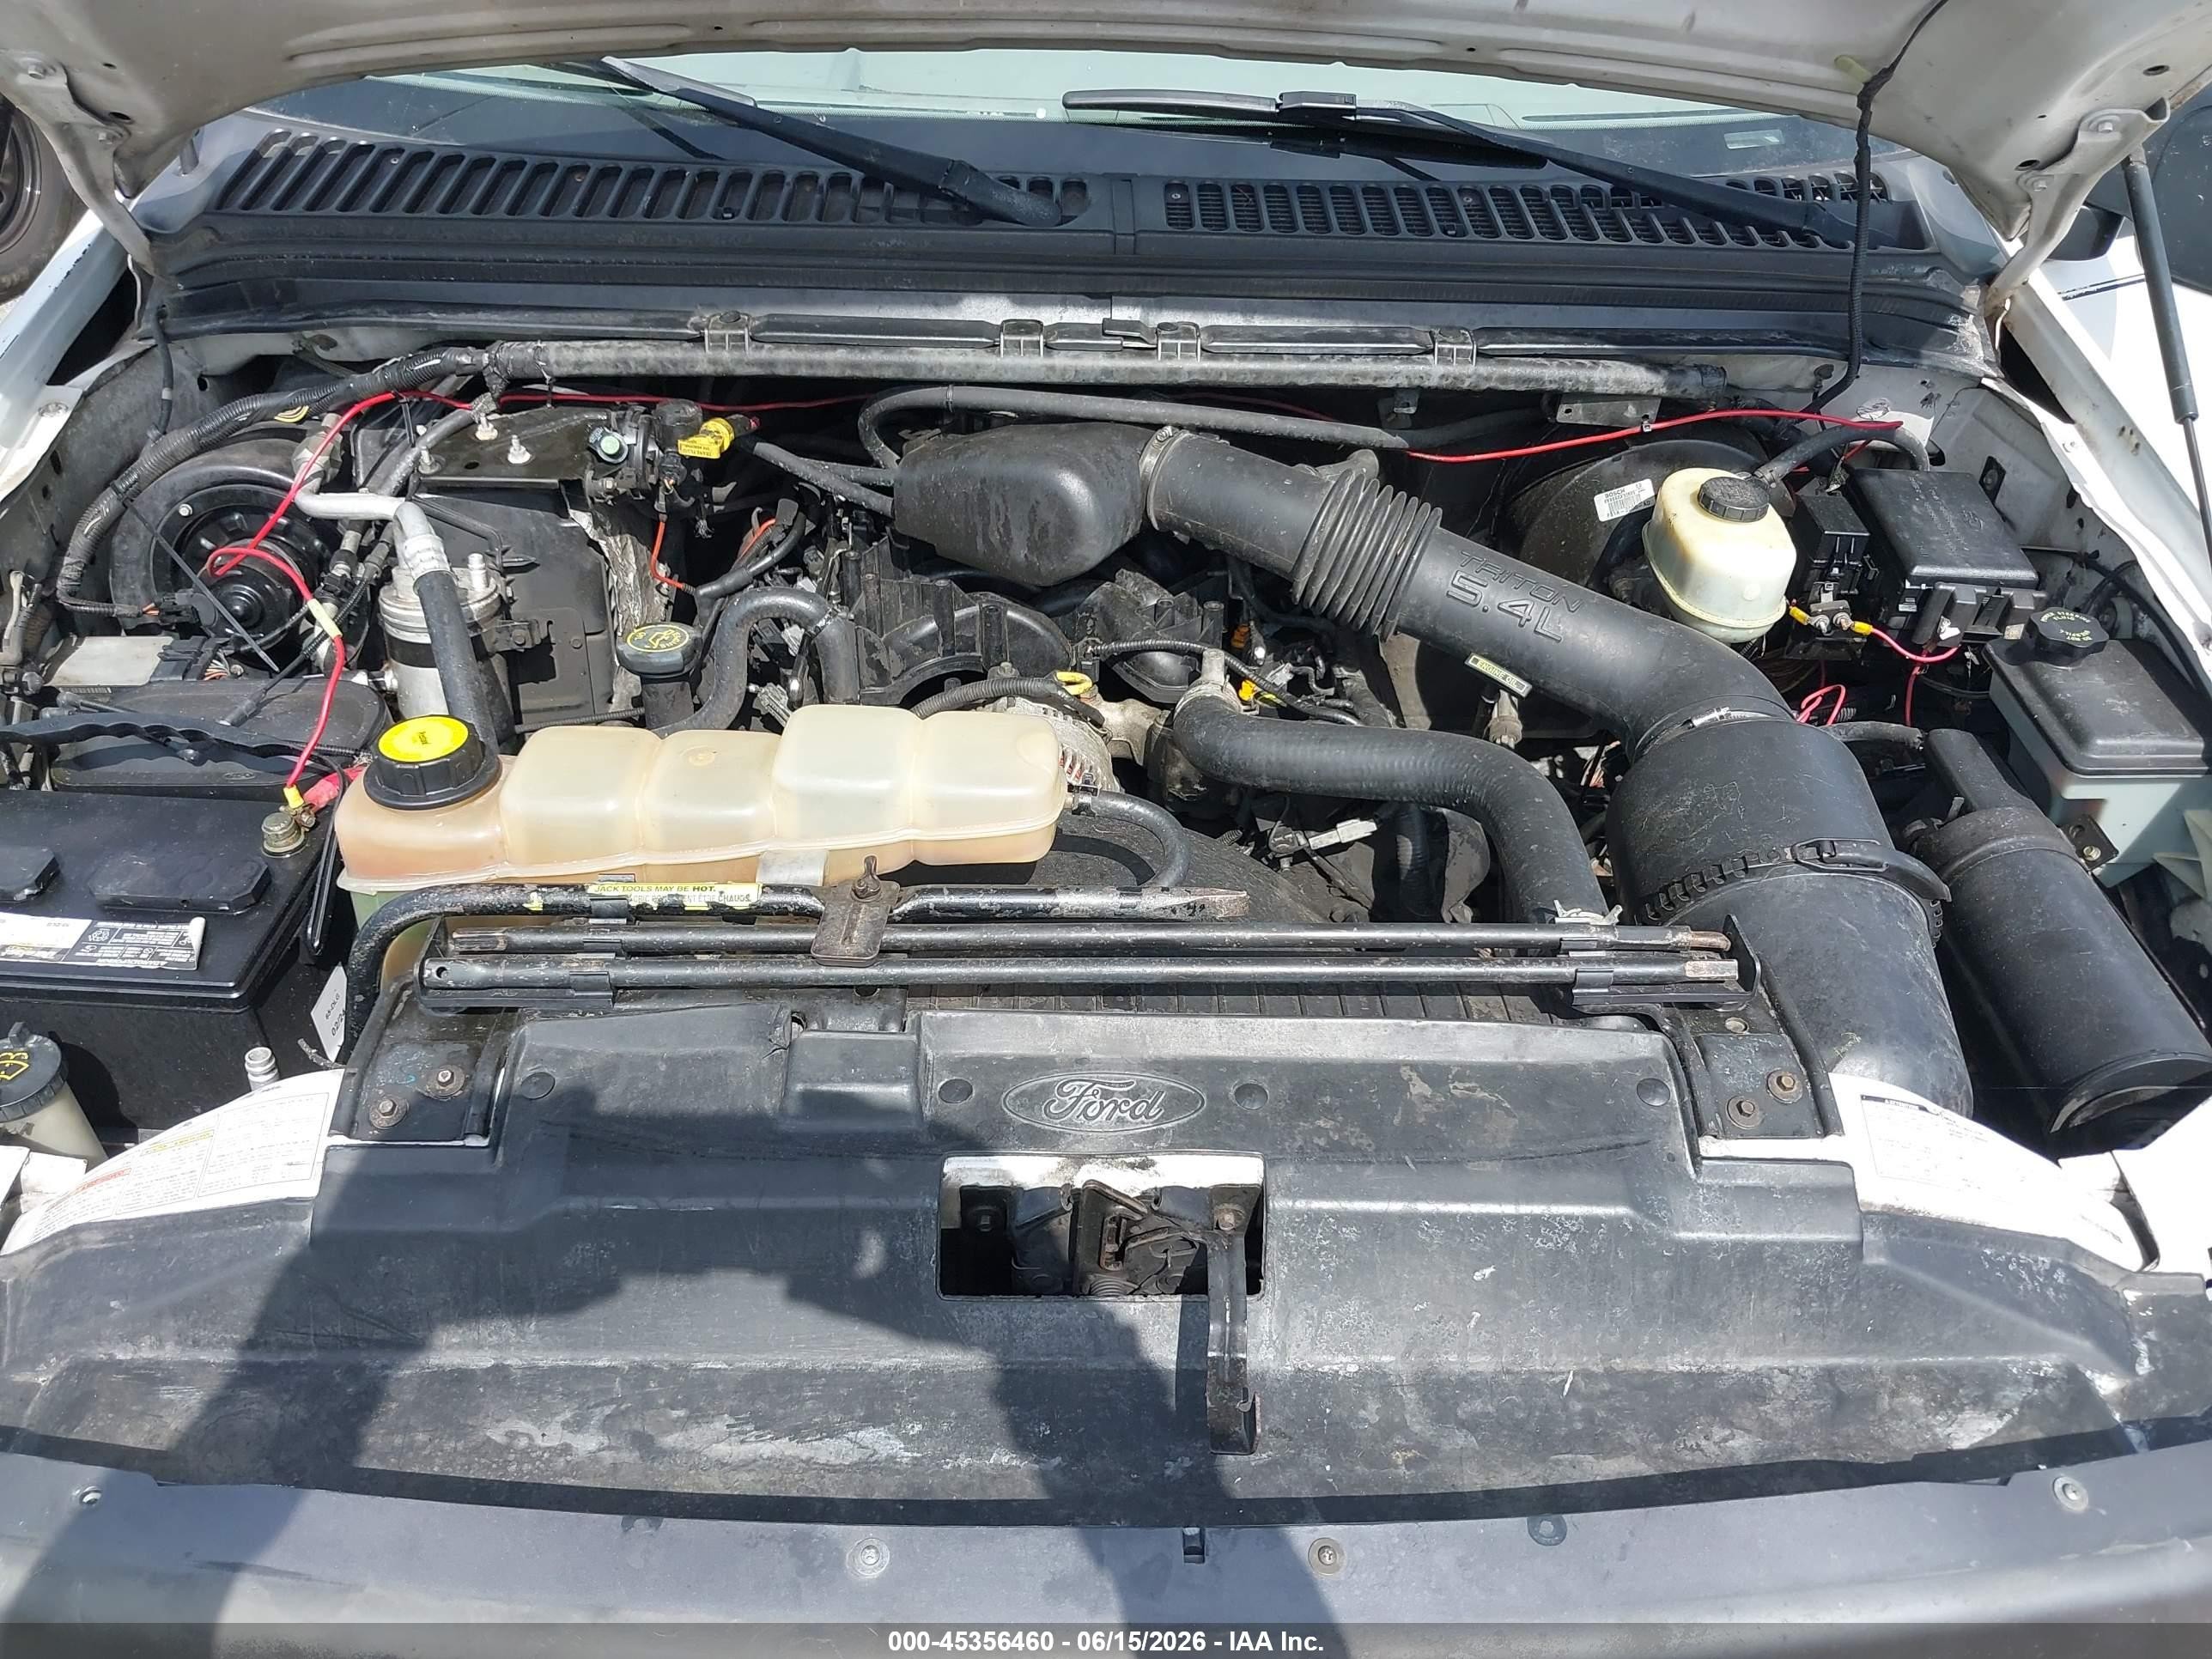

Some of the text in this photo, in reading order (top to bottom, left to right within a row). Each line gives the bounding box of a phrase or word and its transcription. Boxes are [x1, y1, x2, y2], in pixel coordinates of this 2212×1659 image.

[1446, 569, 1563, 644] 5.4L
[1460, 550, 1584, 613] TRITON
[1476, 660, 1518, 688] ENGINE OIL
[1042, 1079, 1166, 1121] Ford
